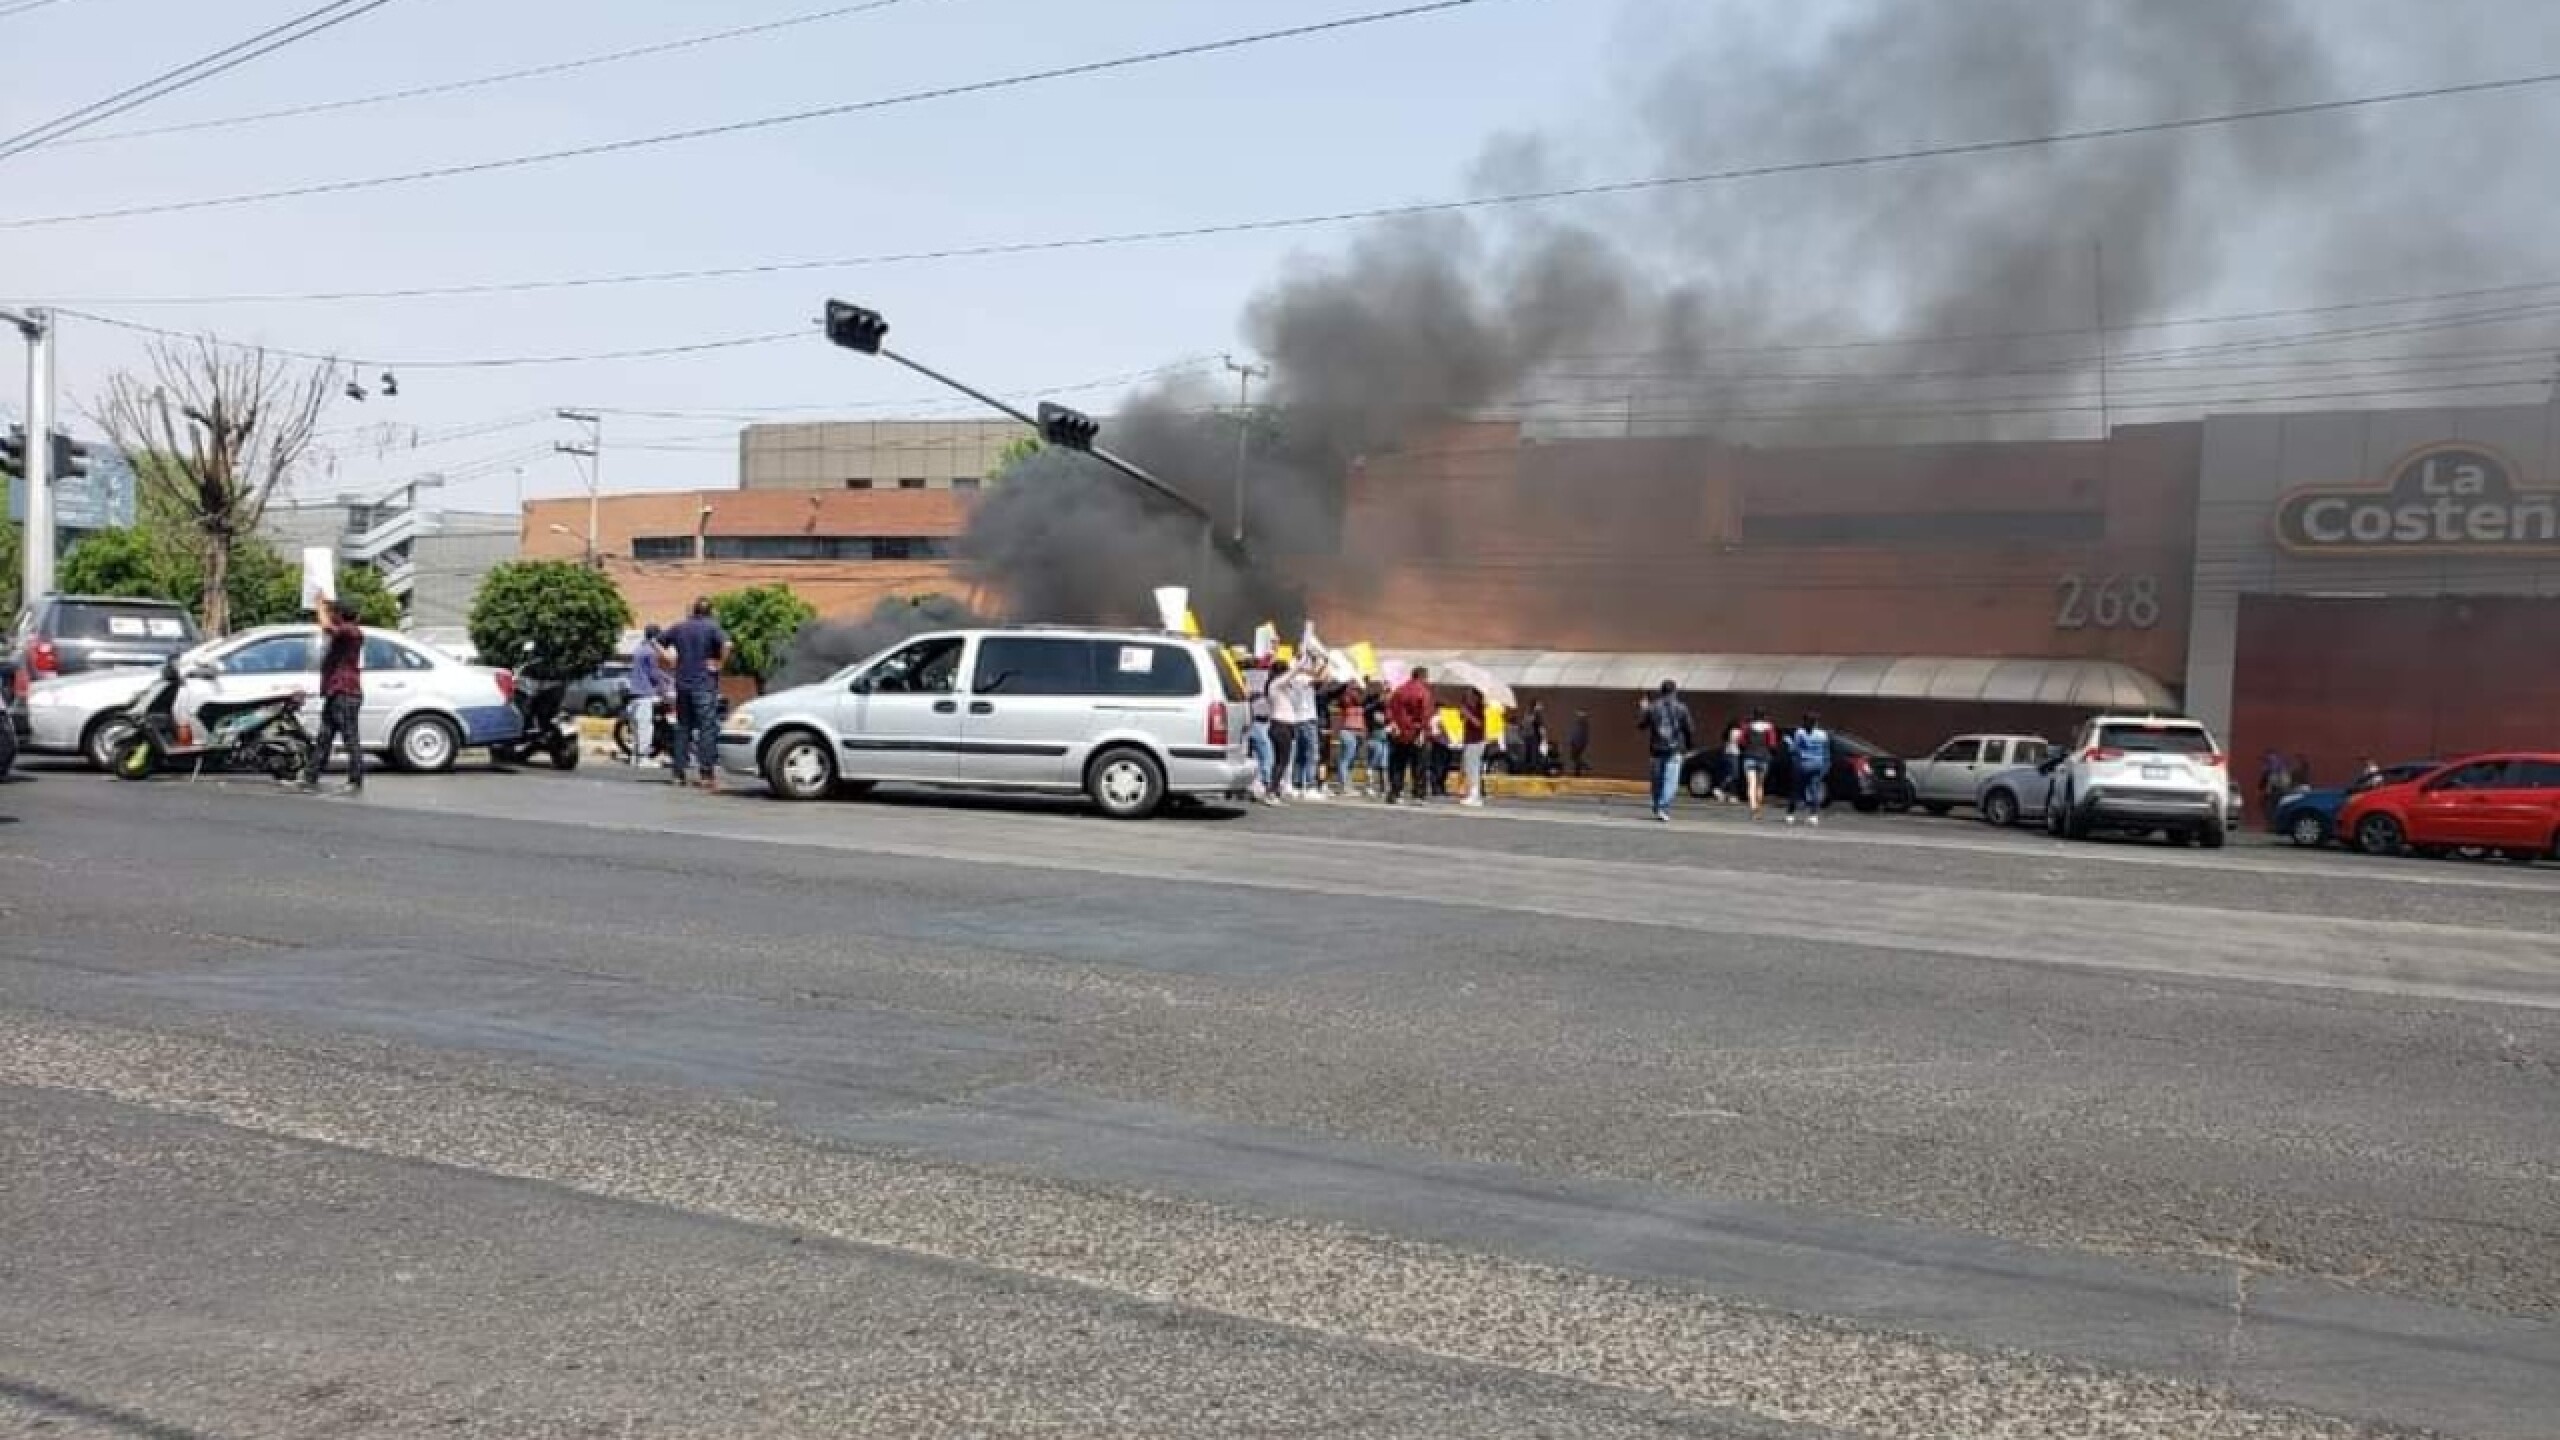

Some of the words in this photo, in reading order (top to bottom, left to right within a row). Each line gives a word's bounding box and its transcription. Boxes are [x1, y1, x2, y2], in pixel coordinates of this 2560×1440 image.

[2421, 459, 2486, 494] La
[2301, 495, 2560, 541] Costeñ
[2056, 574, 2161, 627] 268
